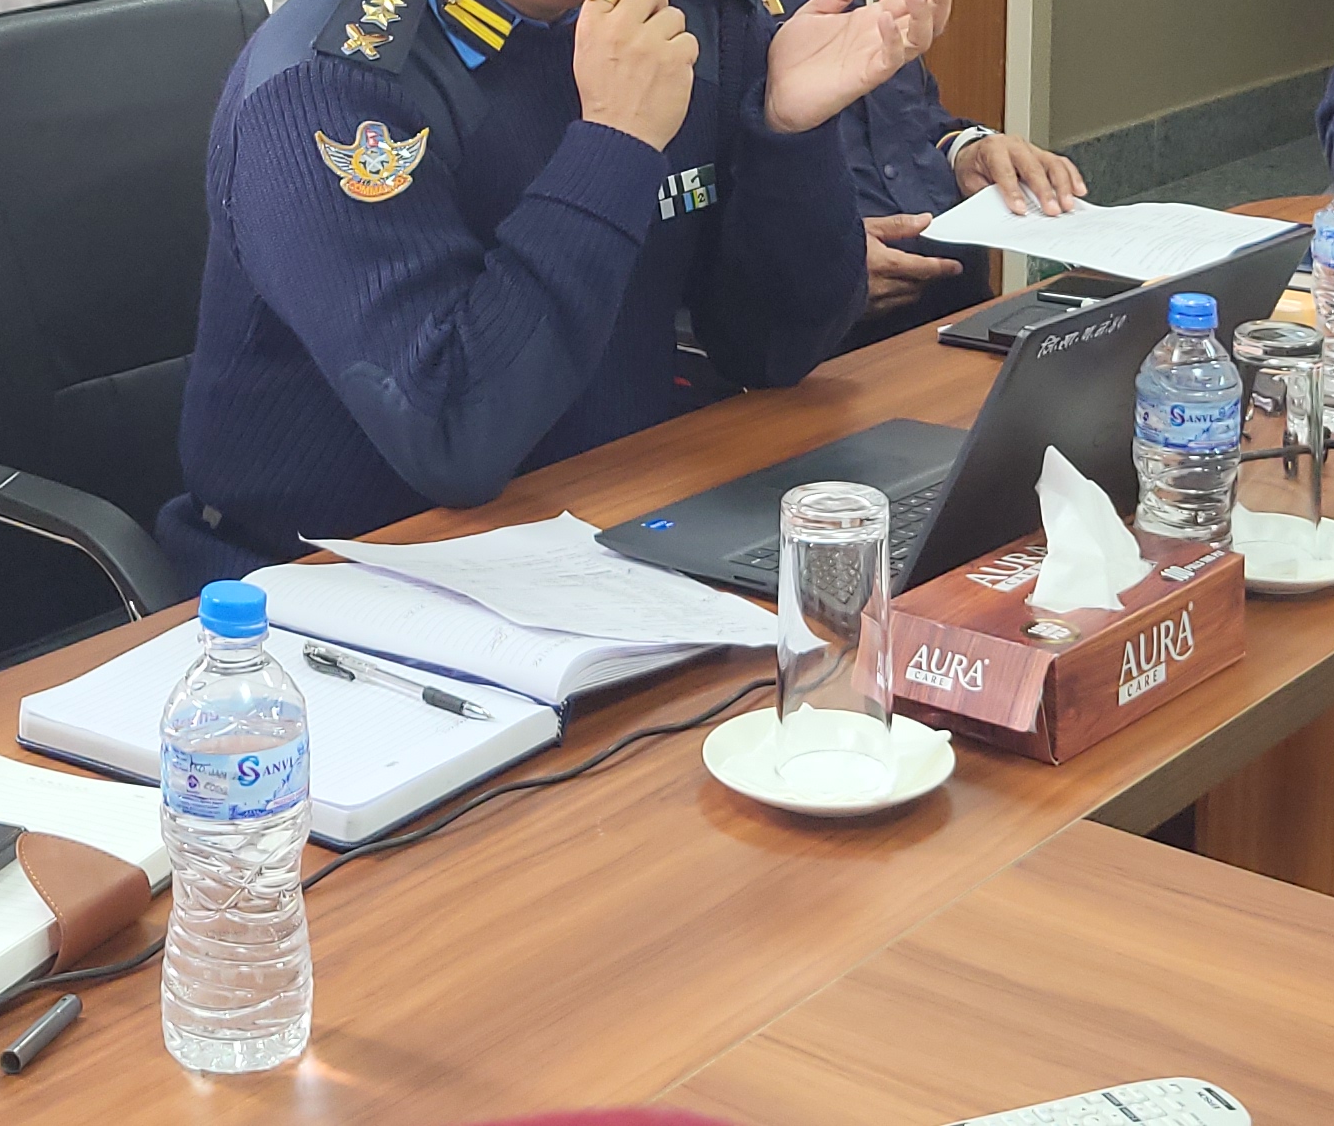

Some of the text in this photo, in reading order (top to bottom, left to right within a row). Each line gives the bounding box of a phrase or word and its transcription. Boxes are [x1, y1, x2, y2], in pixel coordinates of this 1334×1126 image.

[1119, 610, 1194, 686] AURA
[908, 644, 983, 691] AURA
[914, 671, 945, 686] CARE
[1126, 669, 1158, 697] CARE
